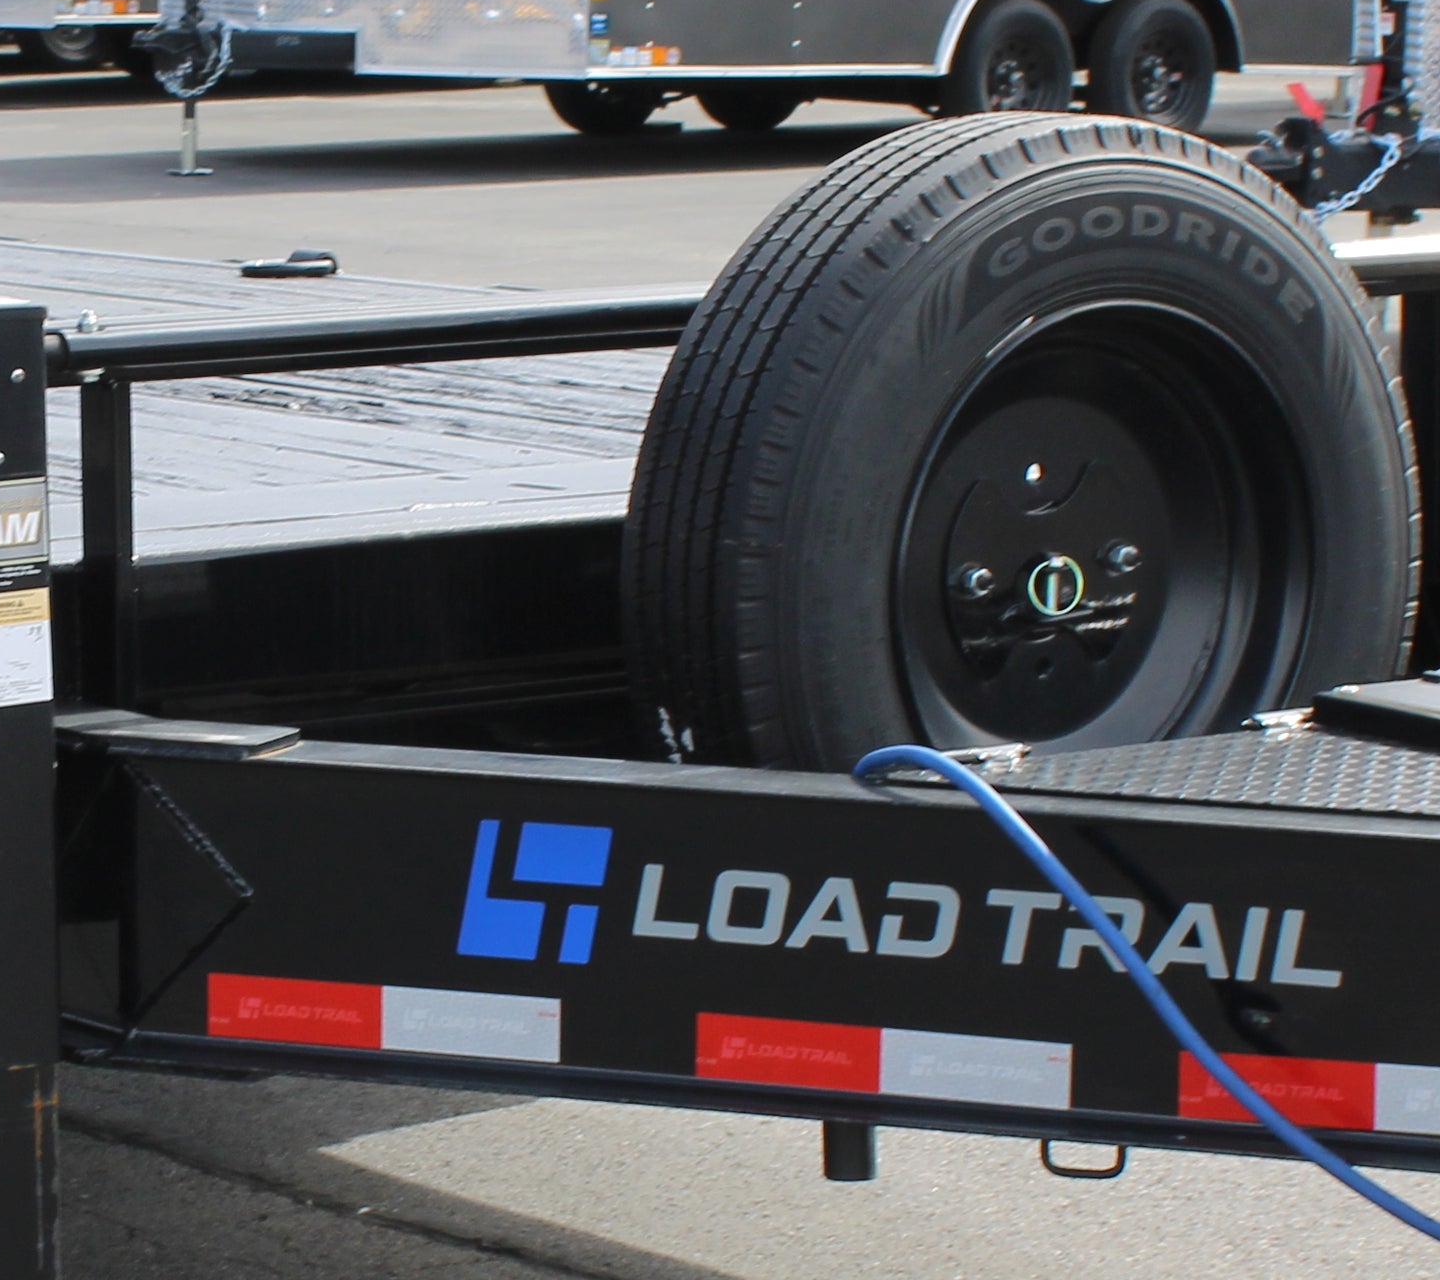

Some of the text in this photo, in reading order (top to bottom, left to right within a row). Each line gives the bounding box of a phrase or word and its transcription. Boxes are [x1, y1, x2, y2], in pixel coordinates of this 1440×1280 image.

[988, 204, 1316, 325] GOODRIDE
[632, 863, 1342, 988] LOAD TRAIL
[263, 1003, 362, 1023] LOAD TRAIL
[747, 1042, 853, 1065] LOAD TRAIL
[1289, 1084, 1345, 1102] TRAIL
